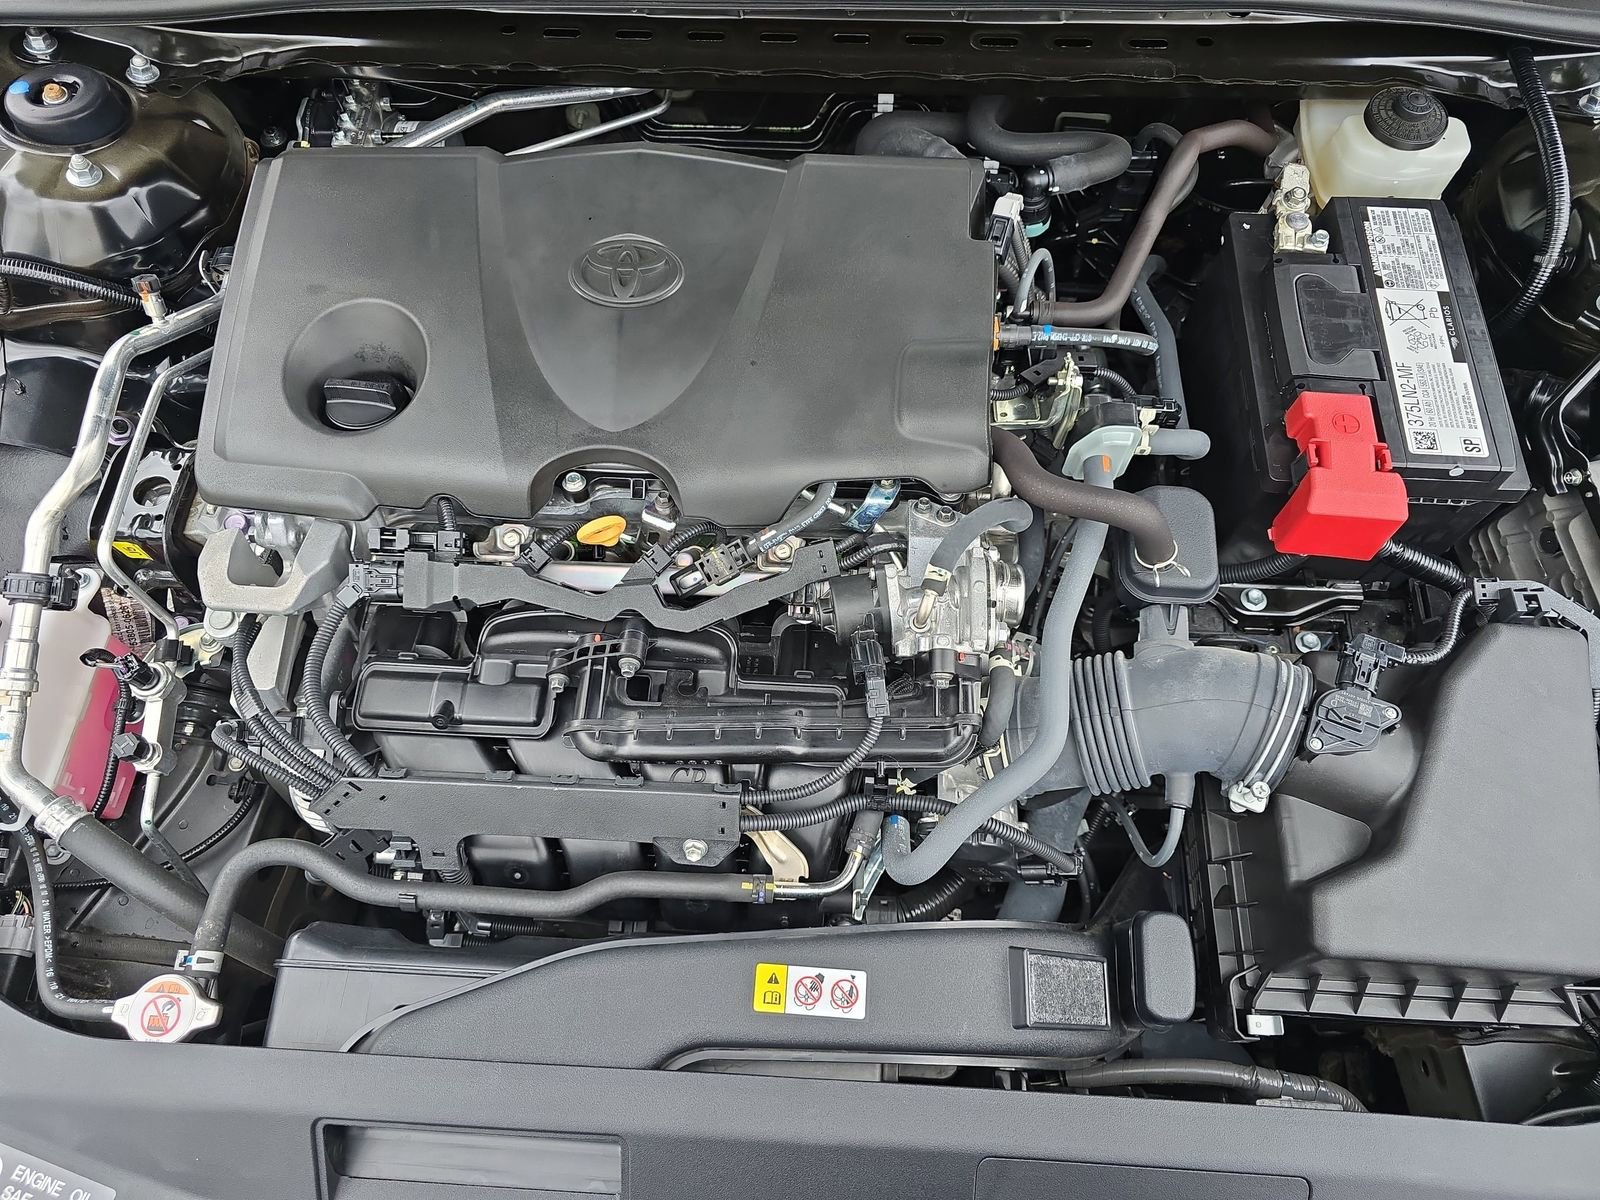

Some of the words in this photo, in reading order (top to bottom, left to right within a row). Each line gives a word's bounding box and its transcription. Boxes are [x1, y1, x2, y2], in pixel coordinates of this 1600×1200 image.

[1427, 306, 1439, 318] Pb
[1442, 305, 1456, 335] CLARIOS
[1395, 361, 1424, 426] 375LN2-MF
[1462, 438, 1482, 452] SP
[43, 910, 52, 935] WATER
[9, 1164, 66, 1198] ENGINE
